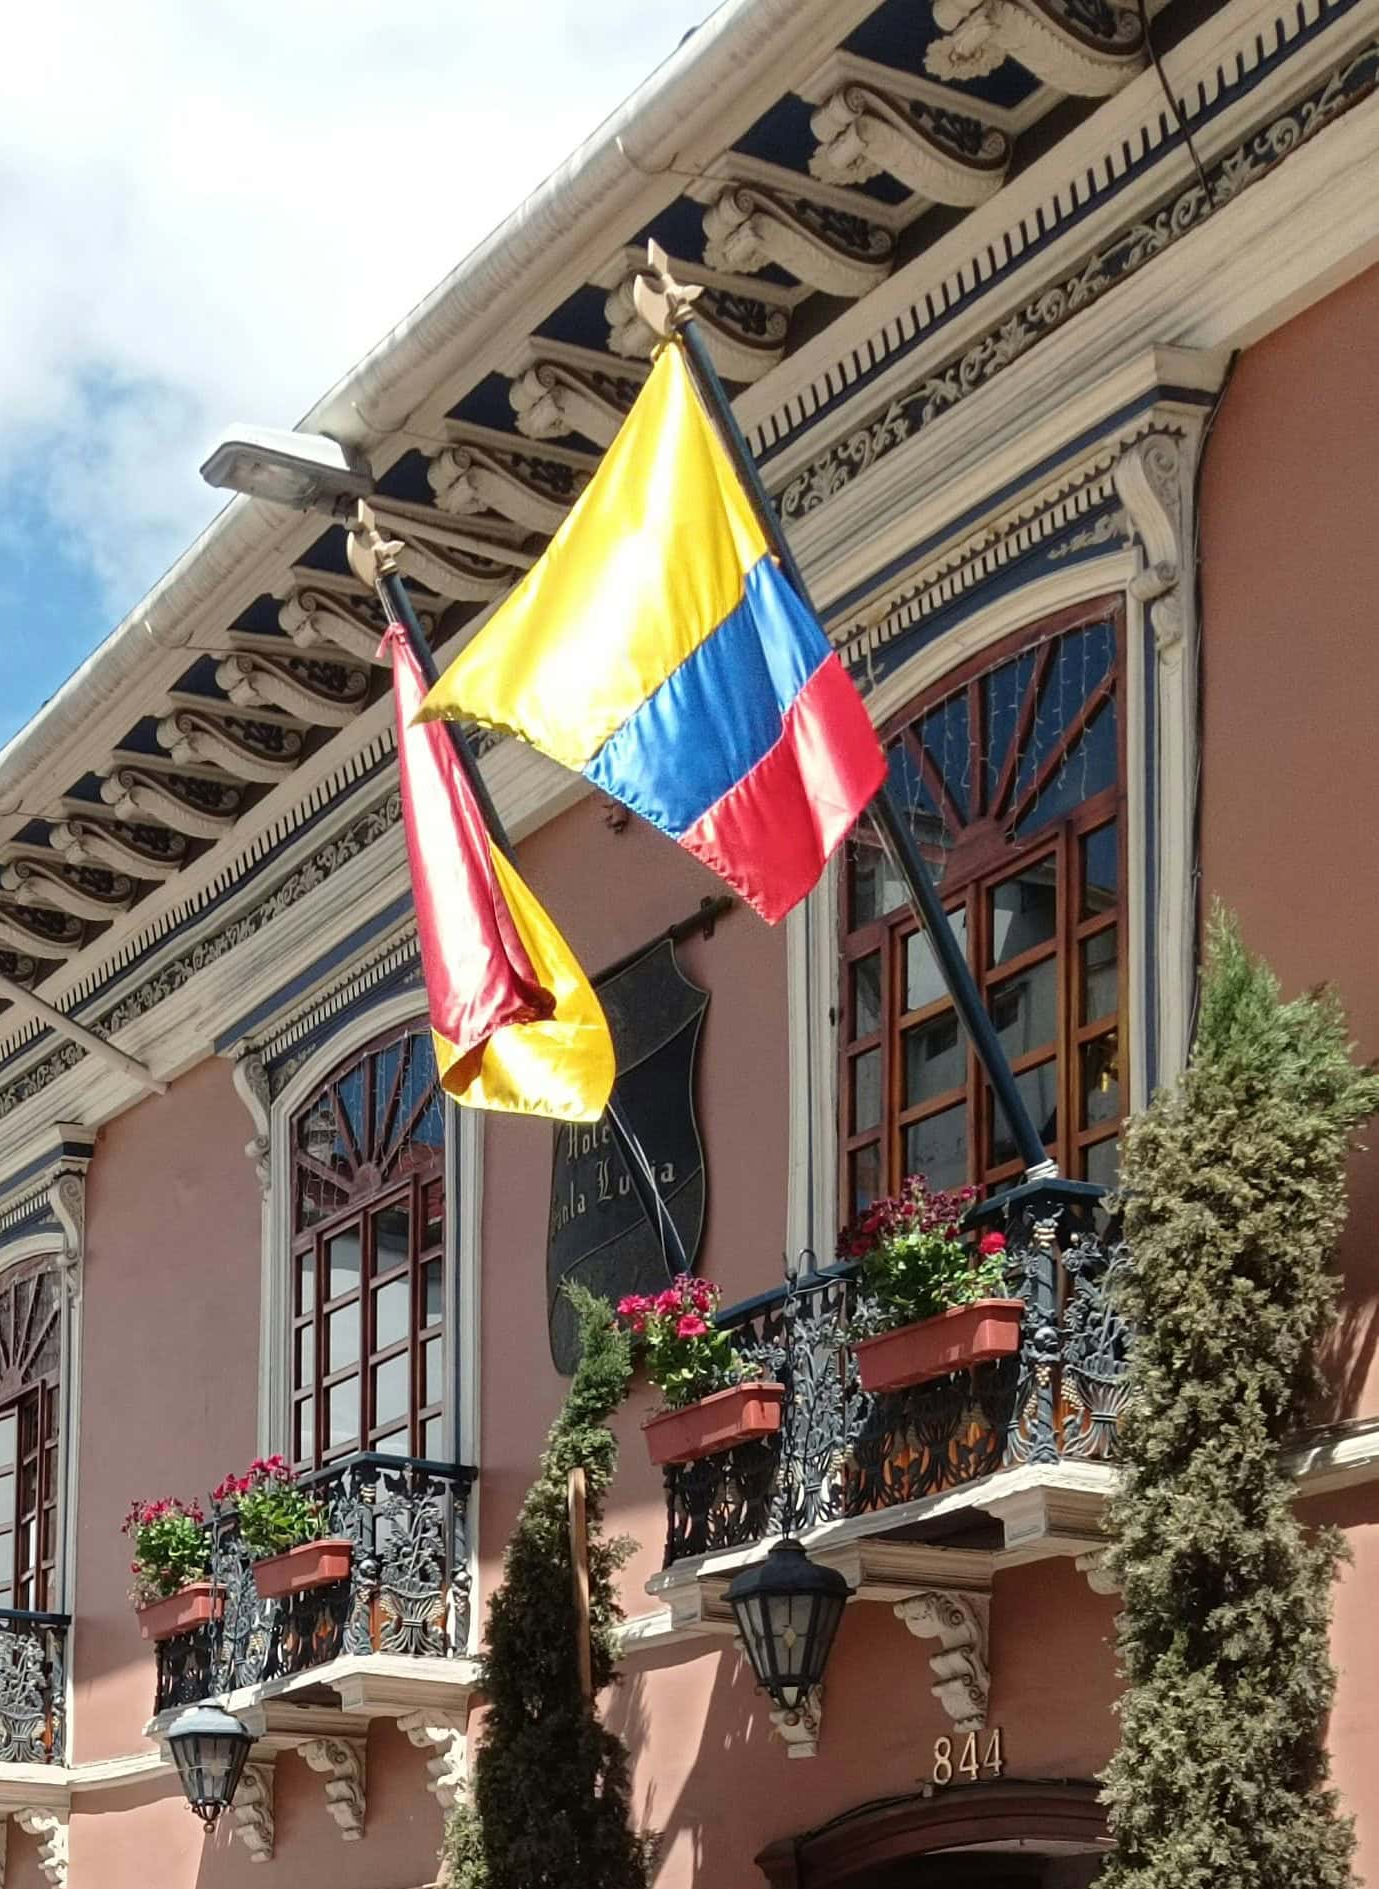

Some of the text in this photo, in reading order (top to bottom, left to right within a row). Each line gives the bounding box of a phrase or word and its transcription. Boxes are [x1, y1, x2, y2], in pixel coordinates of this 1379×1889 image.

[566, 1121, 612, 1164] Hote
[596, 1158, 676, 1203] Luia
[933, 1727, 1003, 1785] 844
